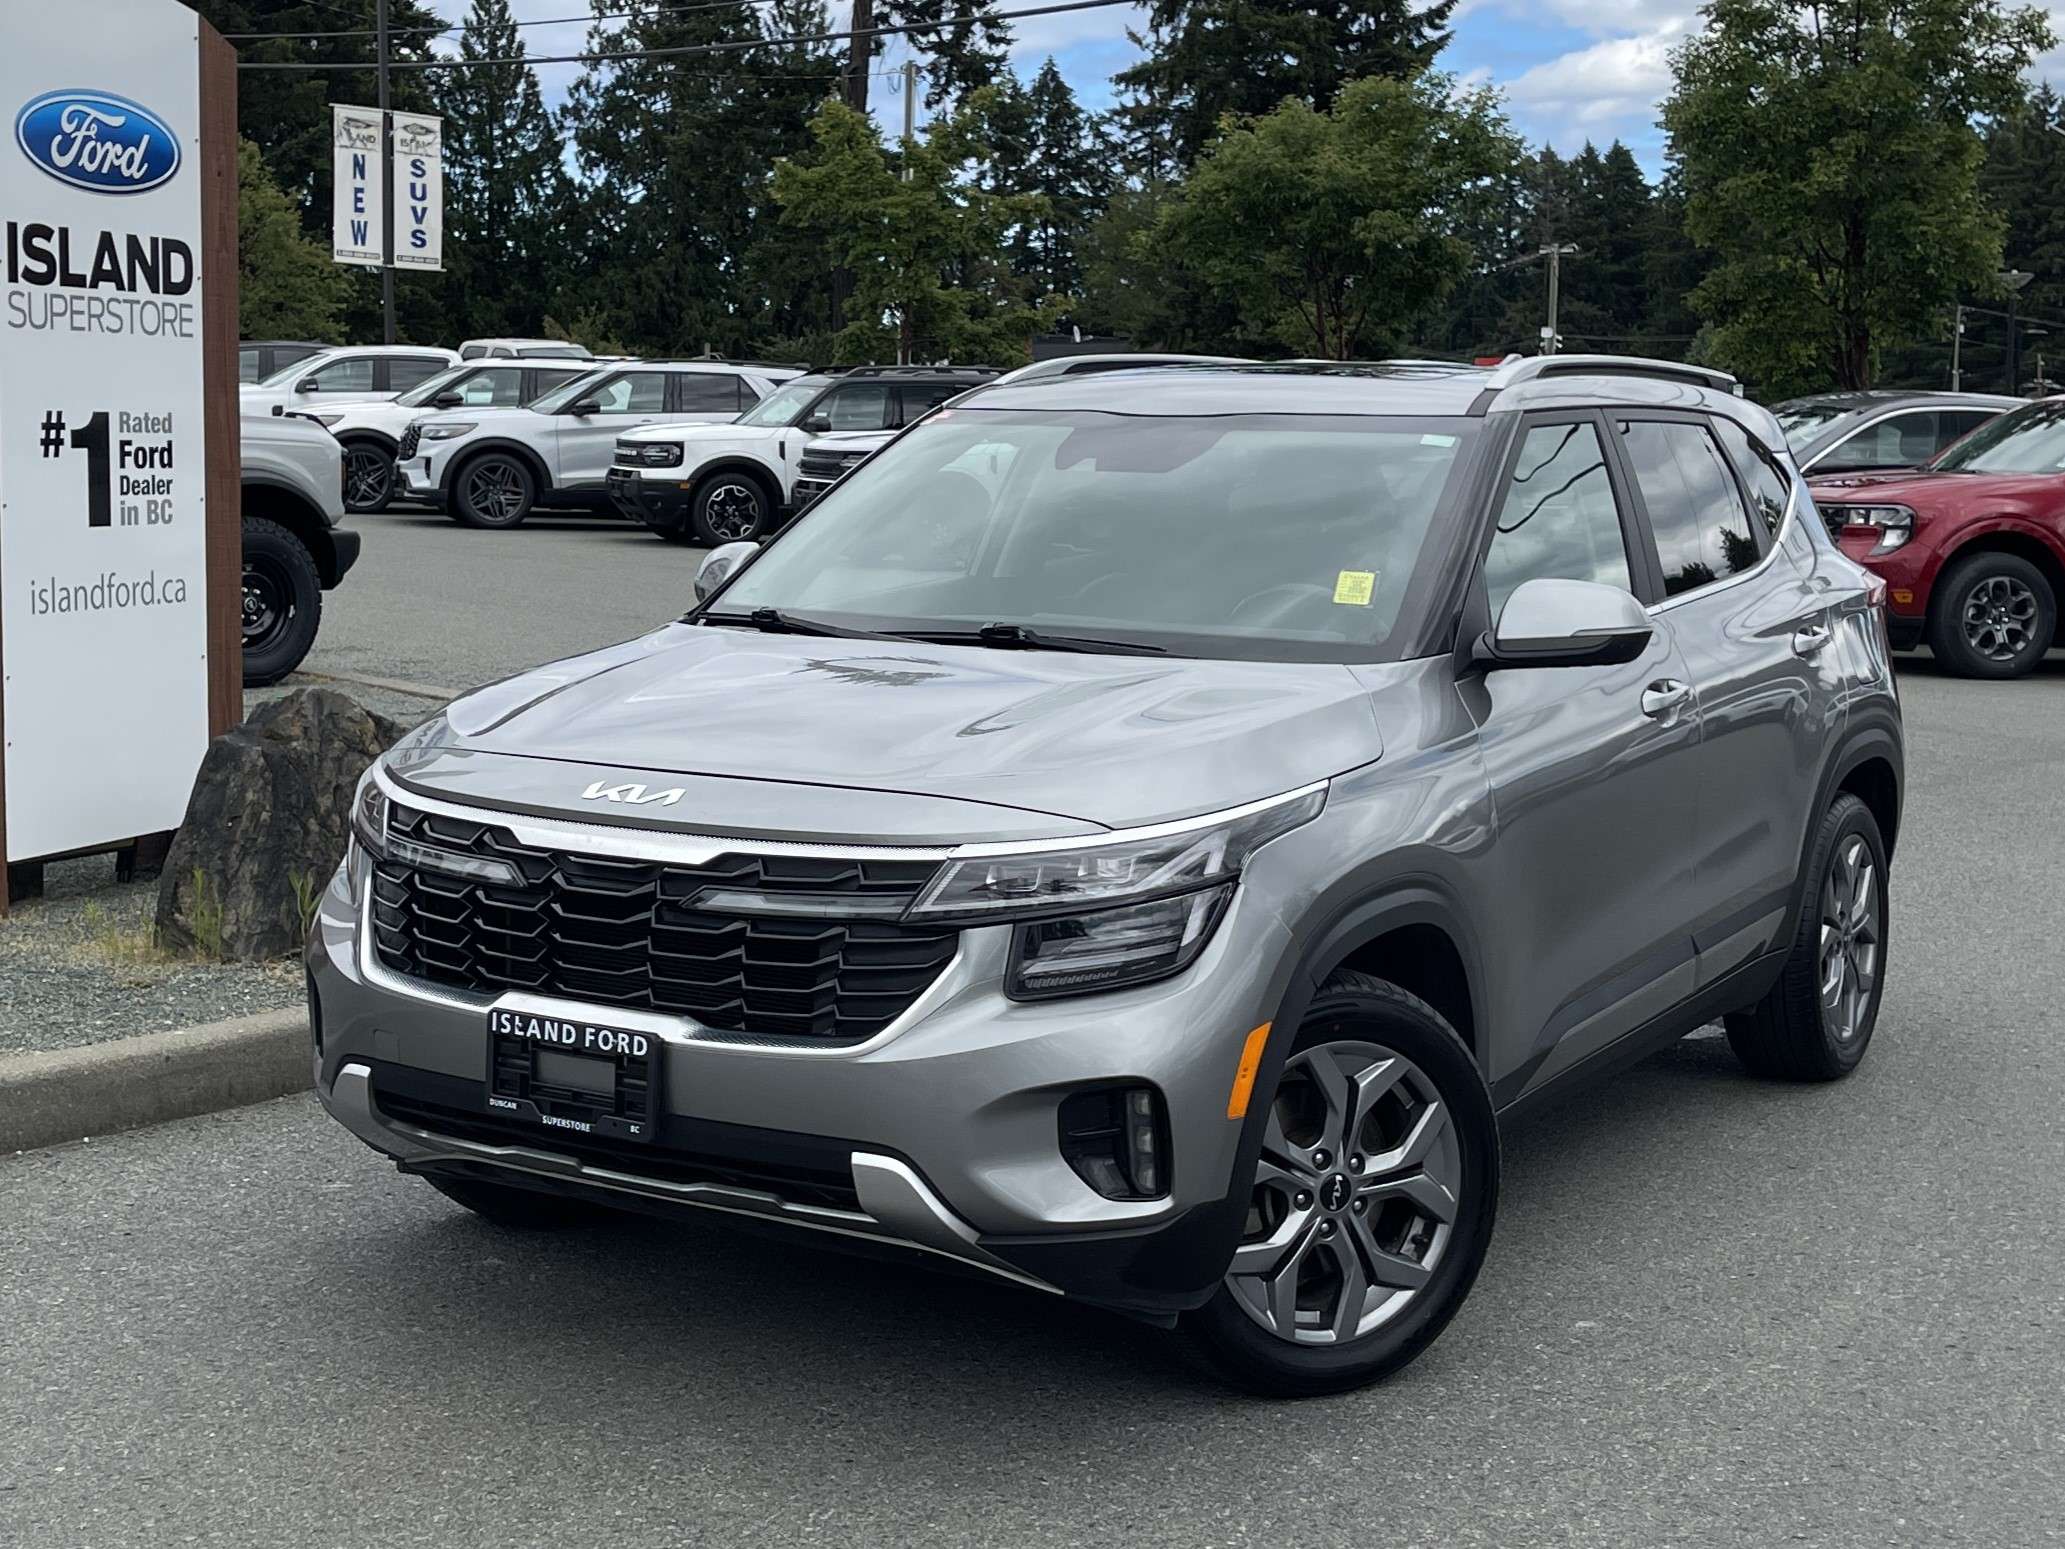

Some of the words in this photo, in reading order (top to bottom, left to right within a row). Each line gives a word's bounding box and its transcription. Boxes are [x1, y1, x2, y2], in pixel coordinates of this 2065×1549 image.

[51, 104, 150, 179] Ford
[351, 153, 368, 247] NEW
[410, 158, 428, 248] SUVS
[6, 221, 194, 296] ISLAND
[8, 290, 194, 338] SUPERSTORE
[119, 411, 173, 434] Rated
[40, 410, 112, 528] #1
[119, 440, 174, 469] Ford
[119, 475, 174, 496] Dealer
[120, 500, 140, 526] in
[146, 499, 174, 525] BC
[30, 570, 187, 615] islandford.ca
[491, 1011, 577, 1044] ISLAND
[585, 1027, 648, 1056] FORD
[489, 1098, 517, 1110] DUNCAN
[542, 1115, 591, 1132] SUPERSTORE
